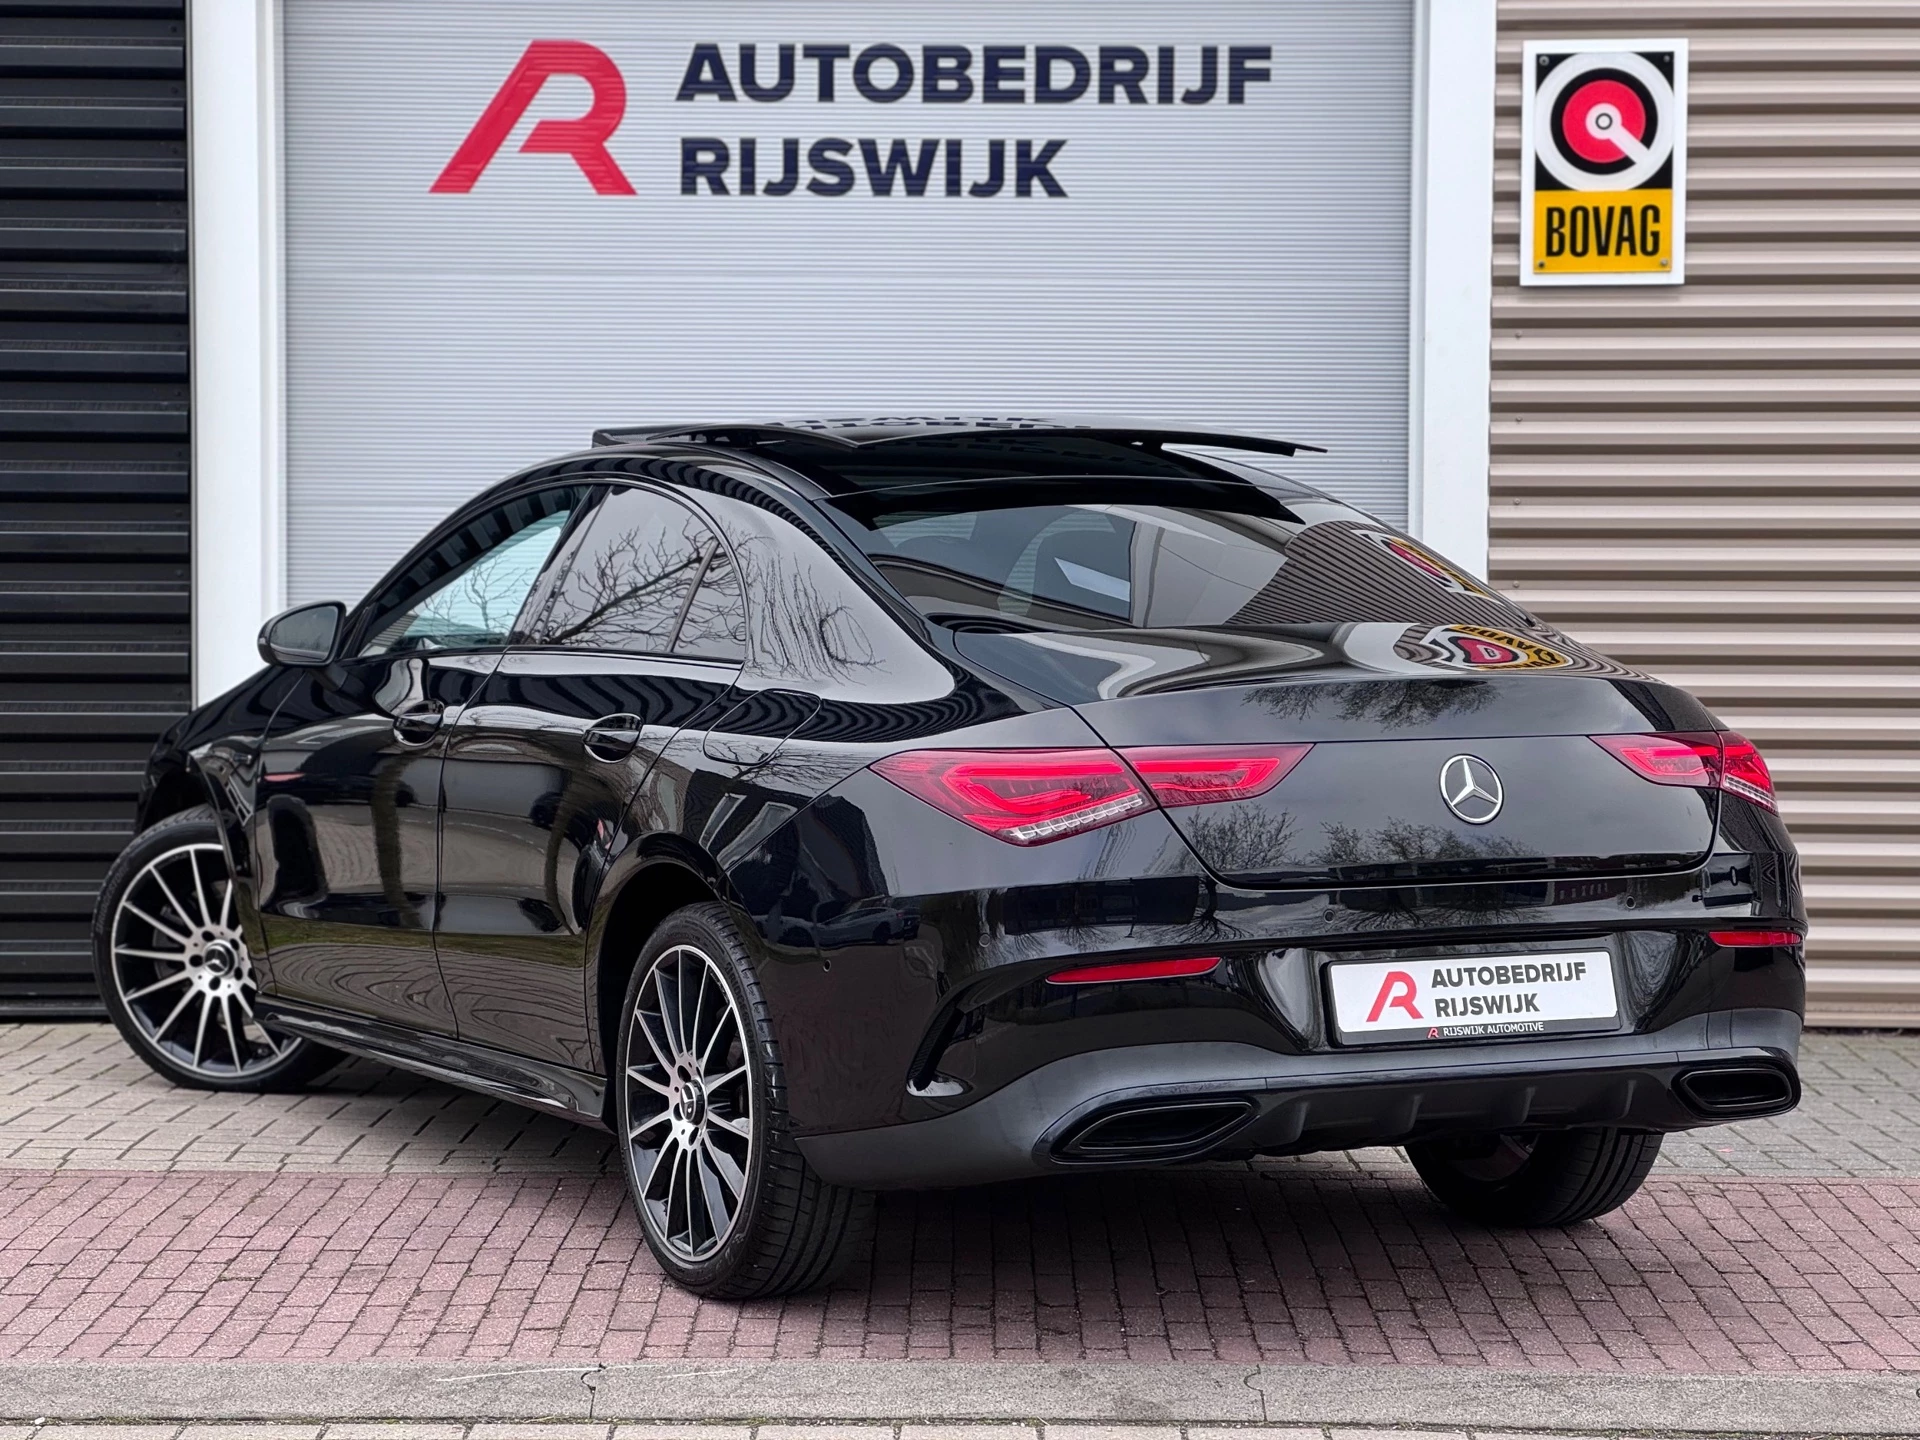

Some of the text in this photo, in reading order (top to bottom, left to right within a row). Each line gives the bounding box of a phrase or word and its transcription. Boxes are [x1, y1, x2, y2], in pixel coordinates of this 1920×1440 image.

[676, 43, 1273, 105] AUTOBEDRIJF
[681, 137, 1068, 198] RIJSWIJK
[1545, 204, 1661, 258] BOVAG
[1431, 961, 1587, 989] AUTOBEDRIJF
[1434, 993, 1540, 1018] RIJSWIJK
[1443, 1025, 1485, 1037] RIJSWIJK
[1487, 1021, 1545, 1034] AUTOMOTIVE
